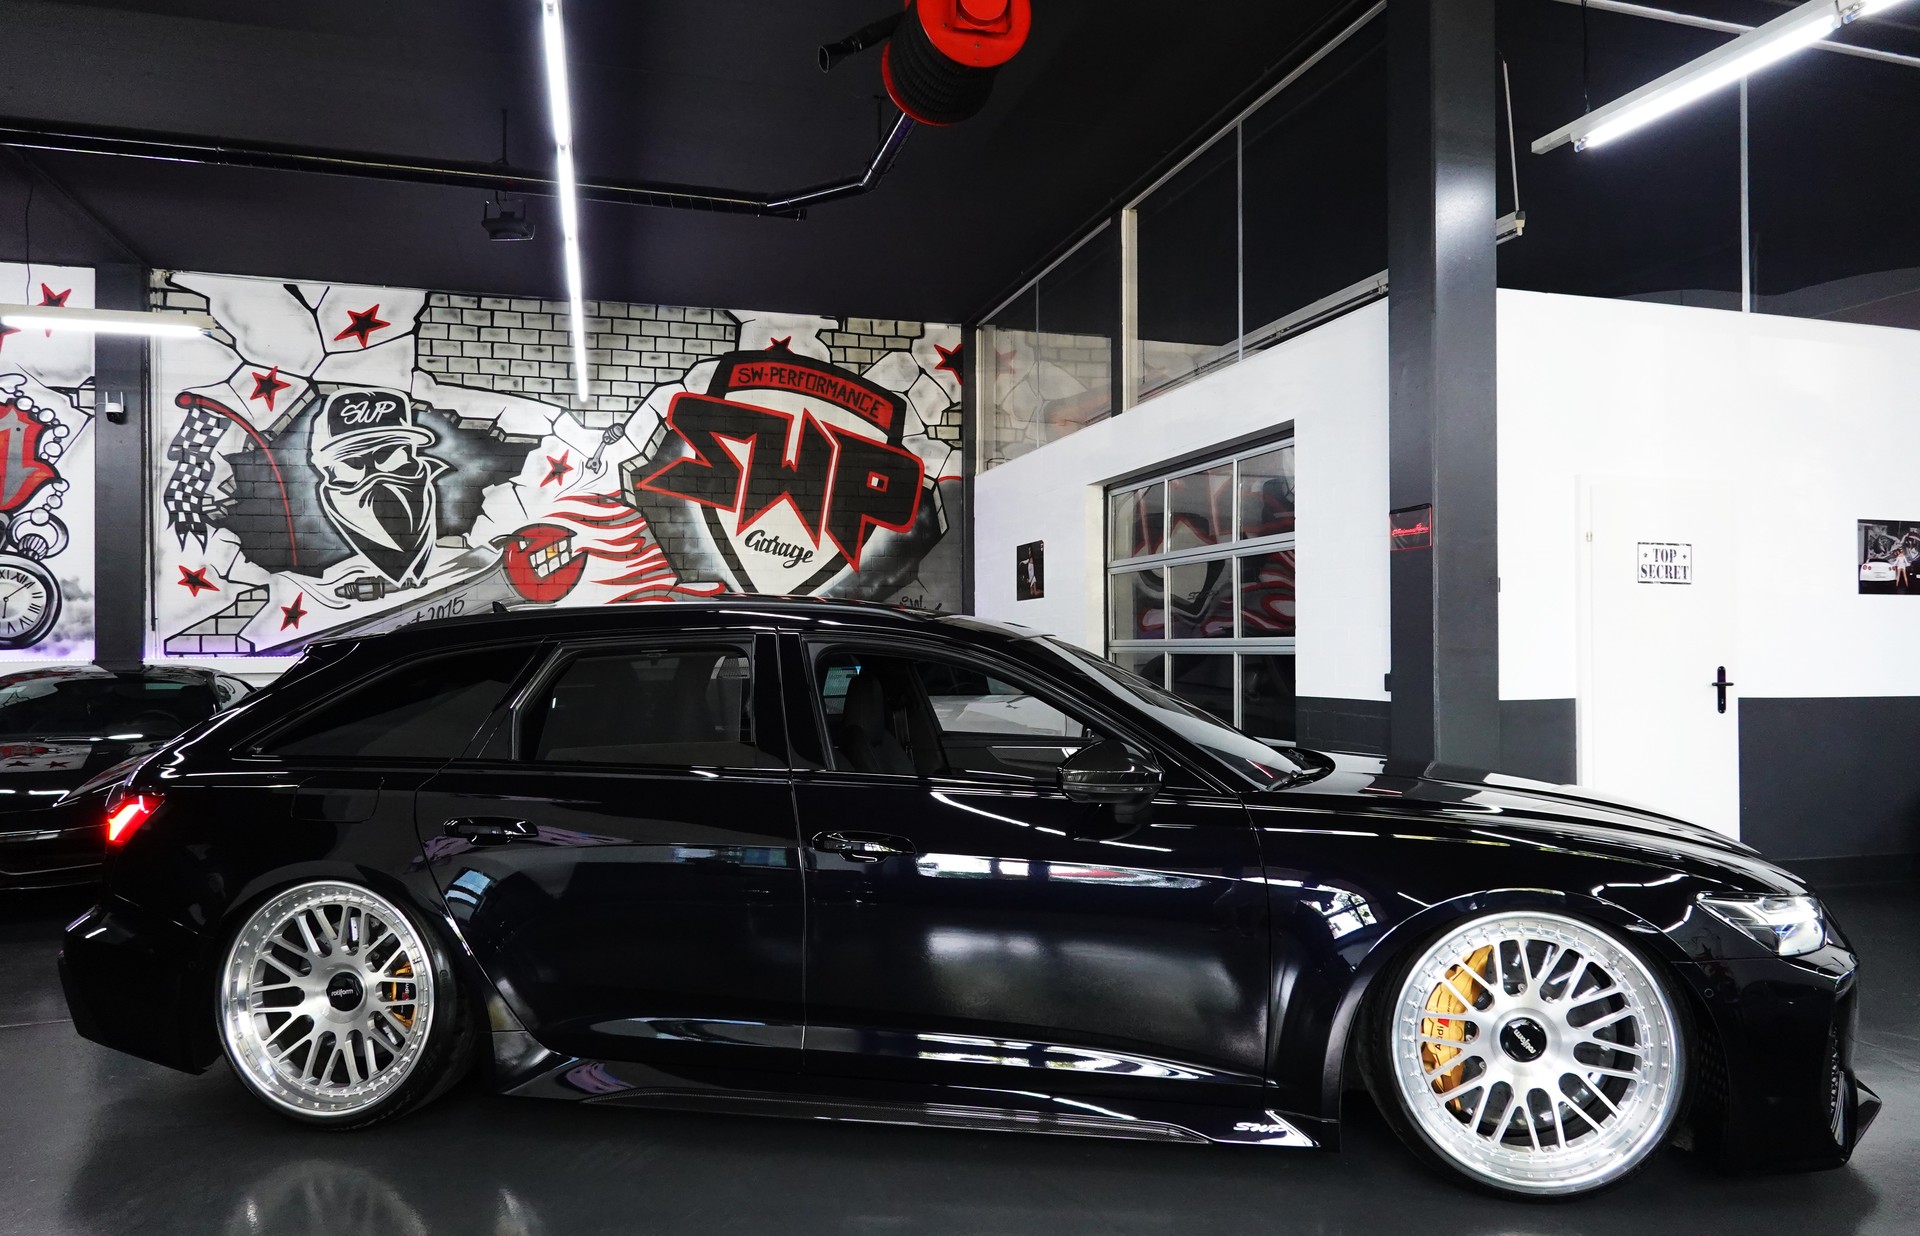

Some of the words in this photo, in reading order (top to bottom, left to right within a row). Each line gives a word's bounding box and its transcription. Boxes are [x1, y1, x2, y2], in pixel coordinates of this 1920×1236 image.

[738, 365, 885, 419] SW-PERFORMANCE
[340, 399, 397, 425] SWP
[635, 391, 925, 573] SWP
[744, 529, 815, 569] Garage
[1652, 548, 1677, 563] TOP
[1640, 563, 1690, 580] SECRET
[427, 592, 468, 620] 2015
[1513, 1028, 1537, 1054] rotiform
